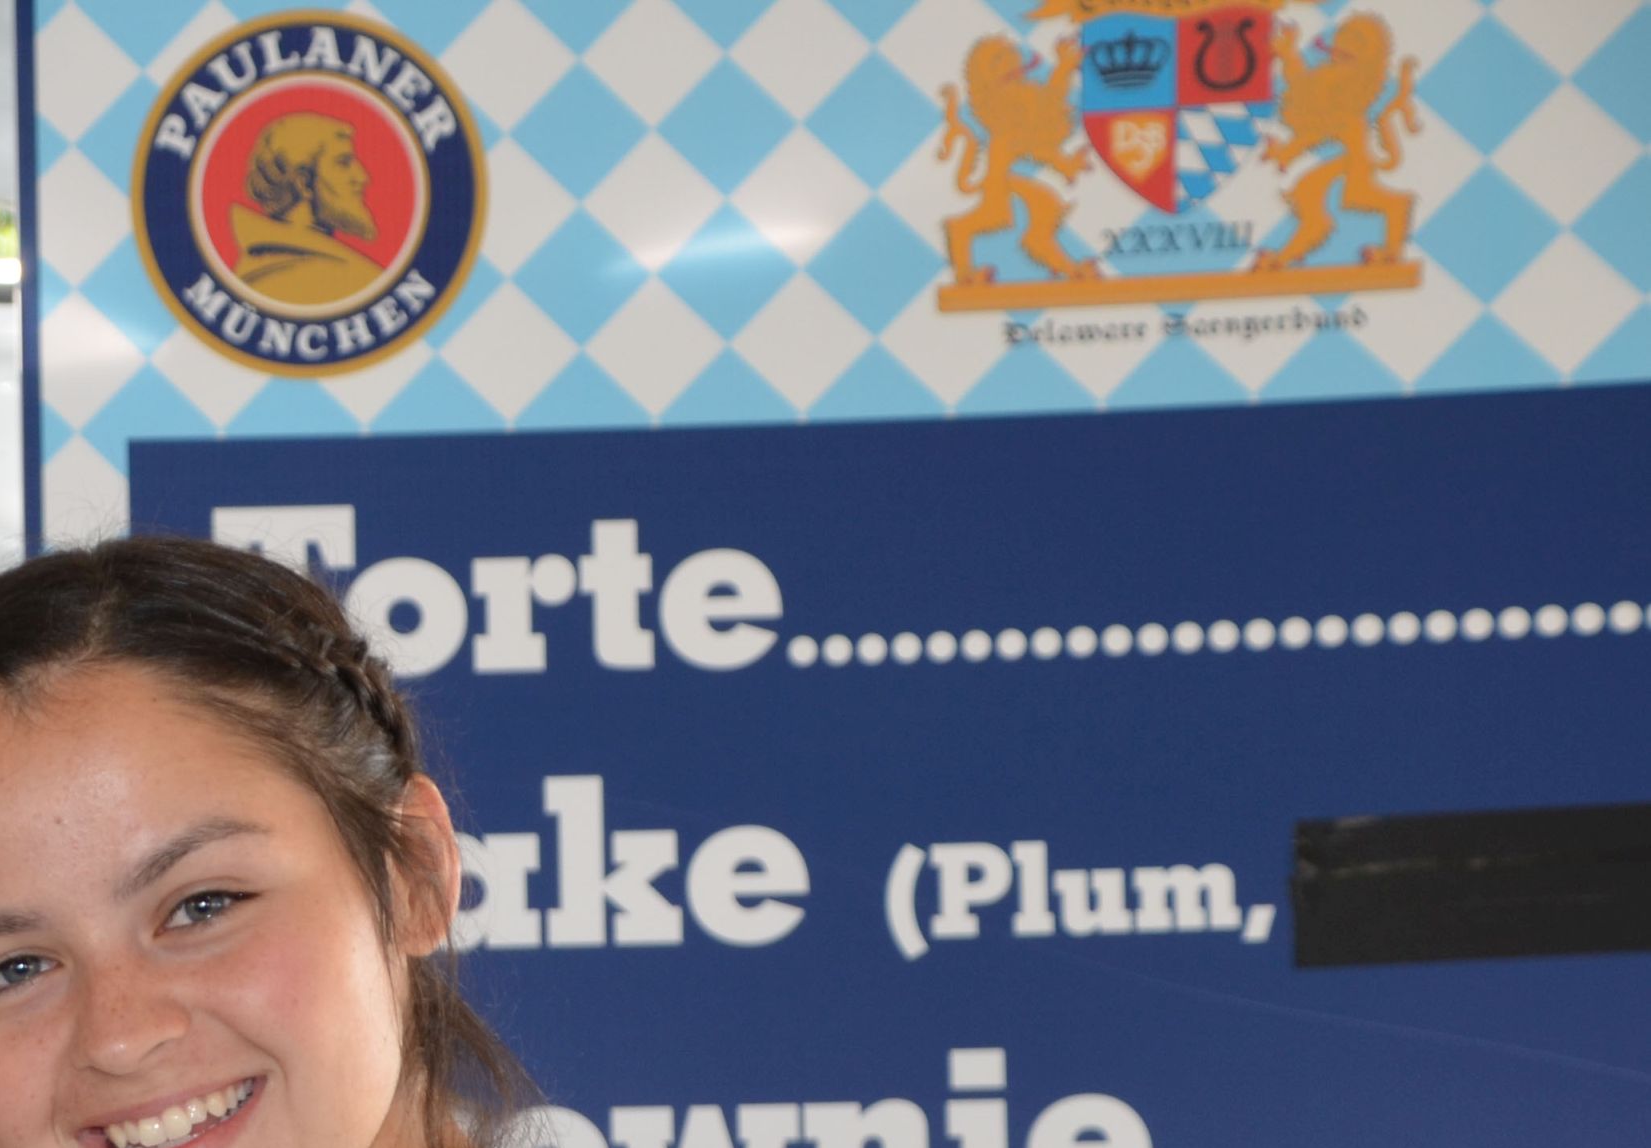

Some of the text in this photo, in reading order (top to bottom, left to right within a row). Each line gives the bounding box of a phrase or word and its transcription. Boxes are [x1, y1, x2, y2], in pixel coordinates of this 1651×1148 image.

[154, 26, 457, 159] PAULANER
[184, 269, 437, 358] MÜNCHEN
[440, 775, 1277, 960] ake (Plum,
